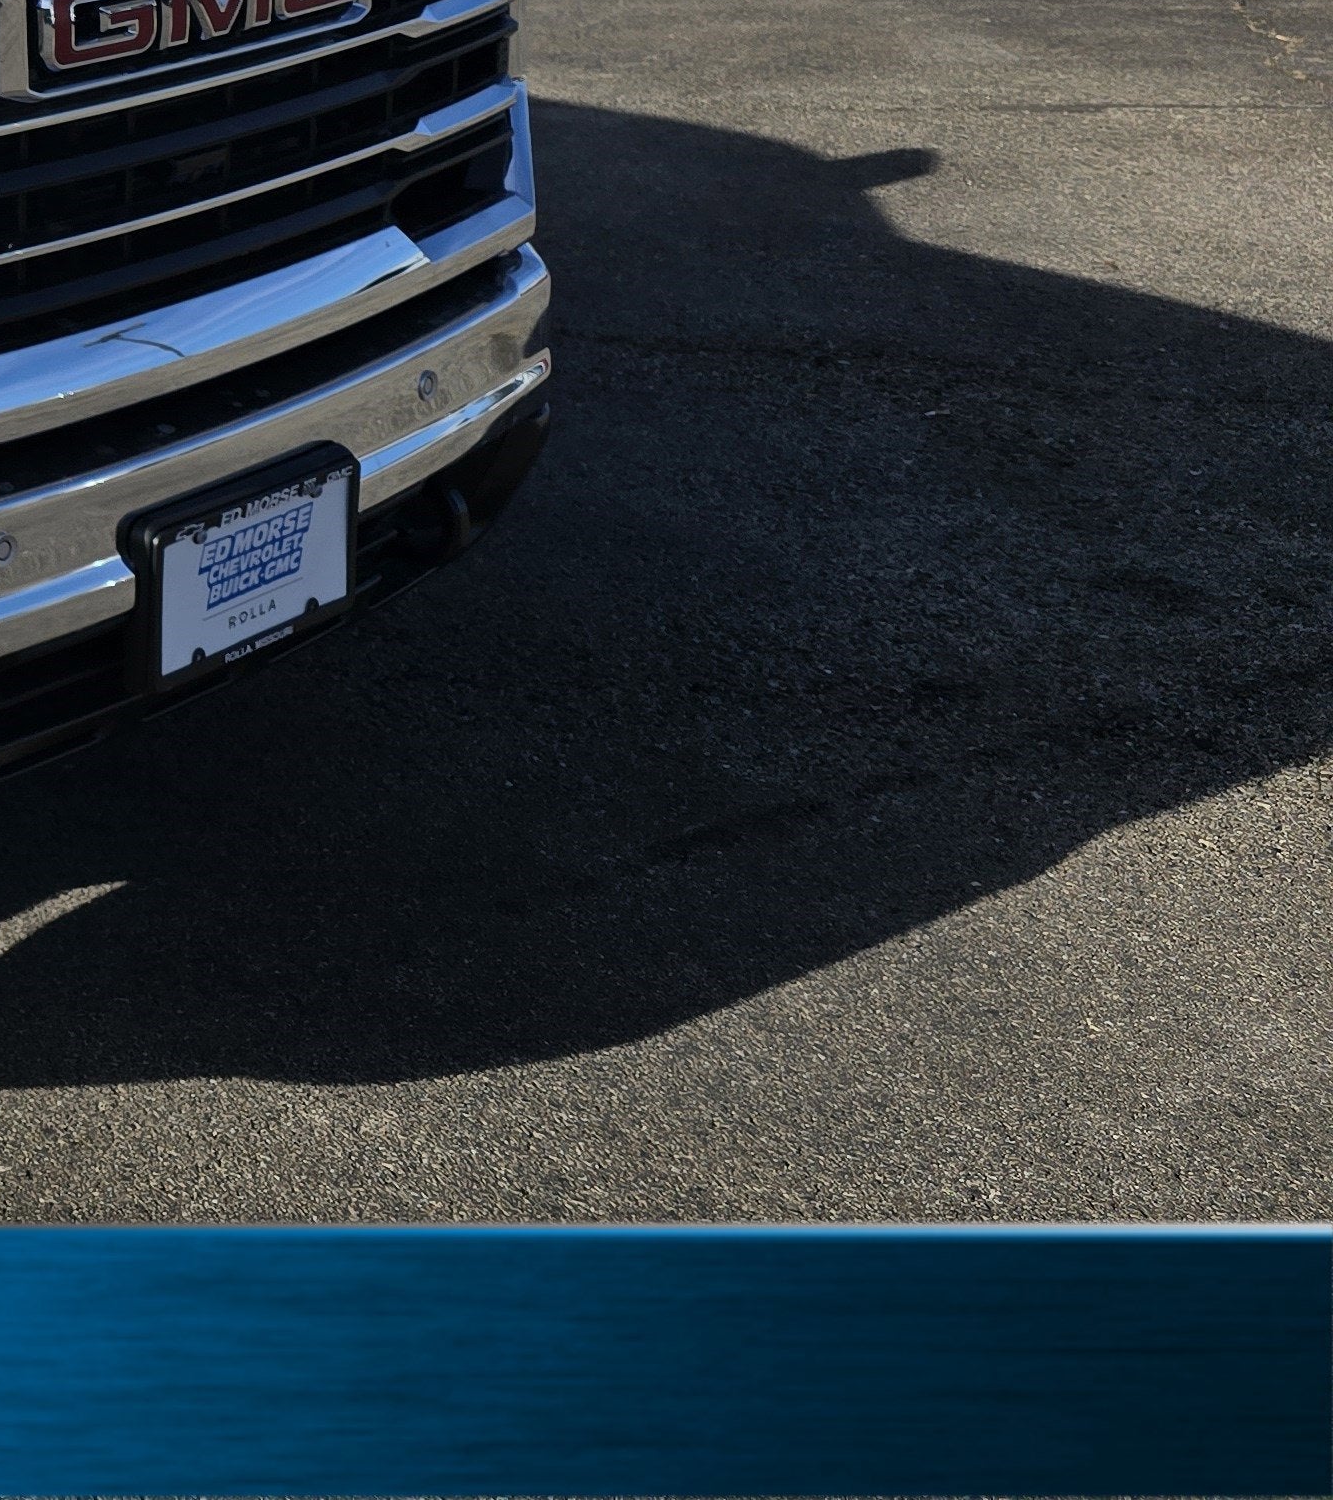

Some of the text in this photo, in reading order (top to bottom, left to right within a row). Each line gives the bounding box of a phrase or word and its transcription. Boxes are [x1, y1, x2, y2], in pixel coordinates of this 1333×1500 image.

[200, 503, 313, 571] ED MORSE
[208, 534, 304, 585] CHEVROLET
[227, 599, 278, 630] ROLLA
